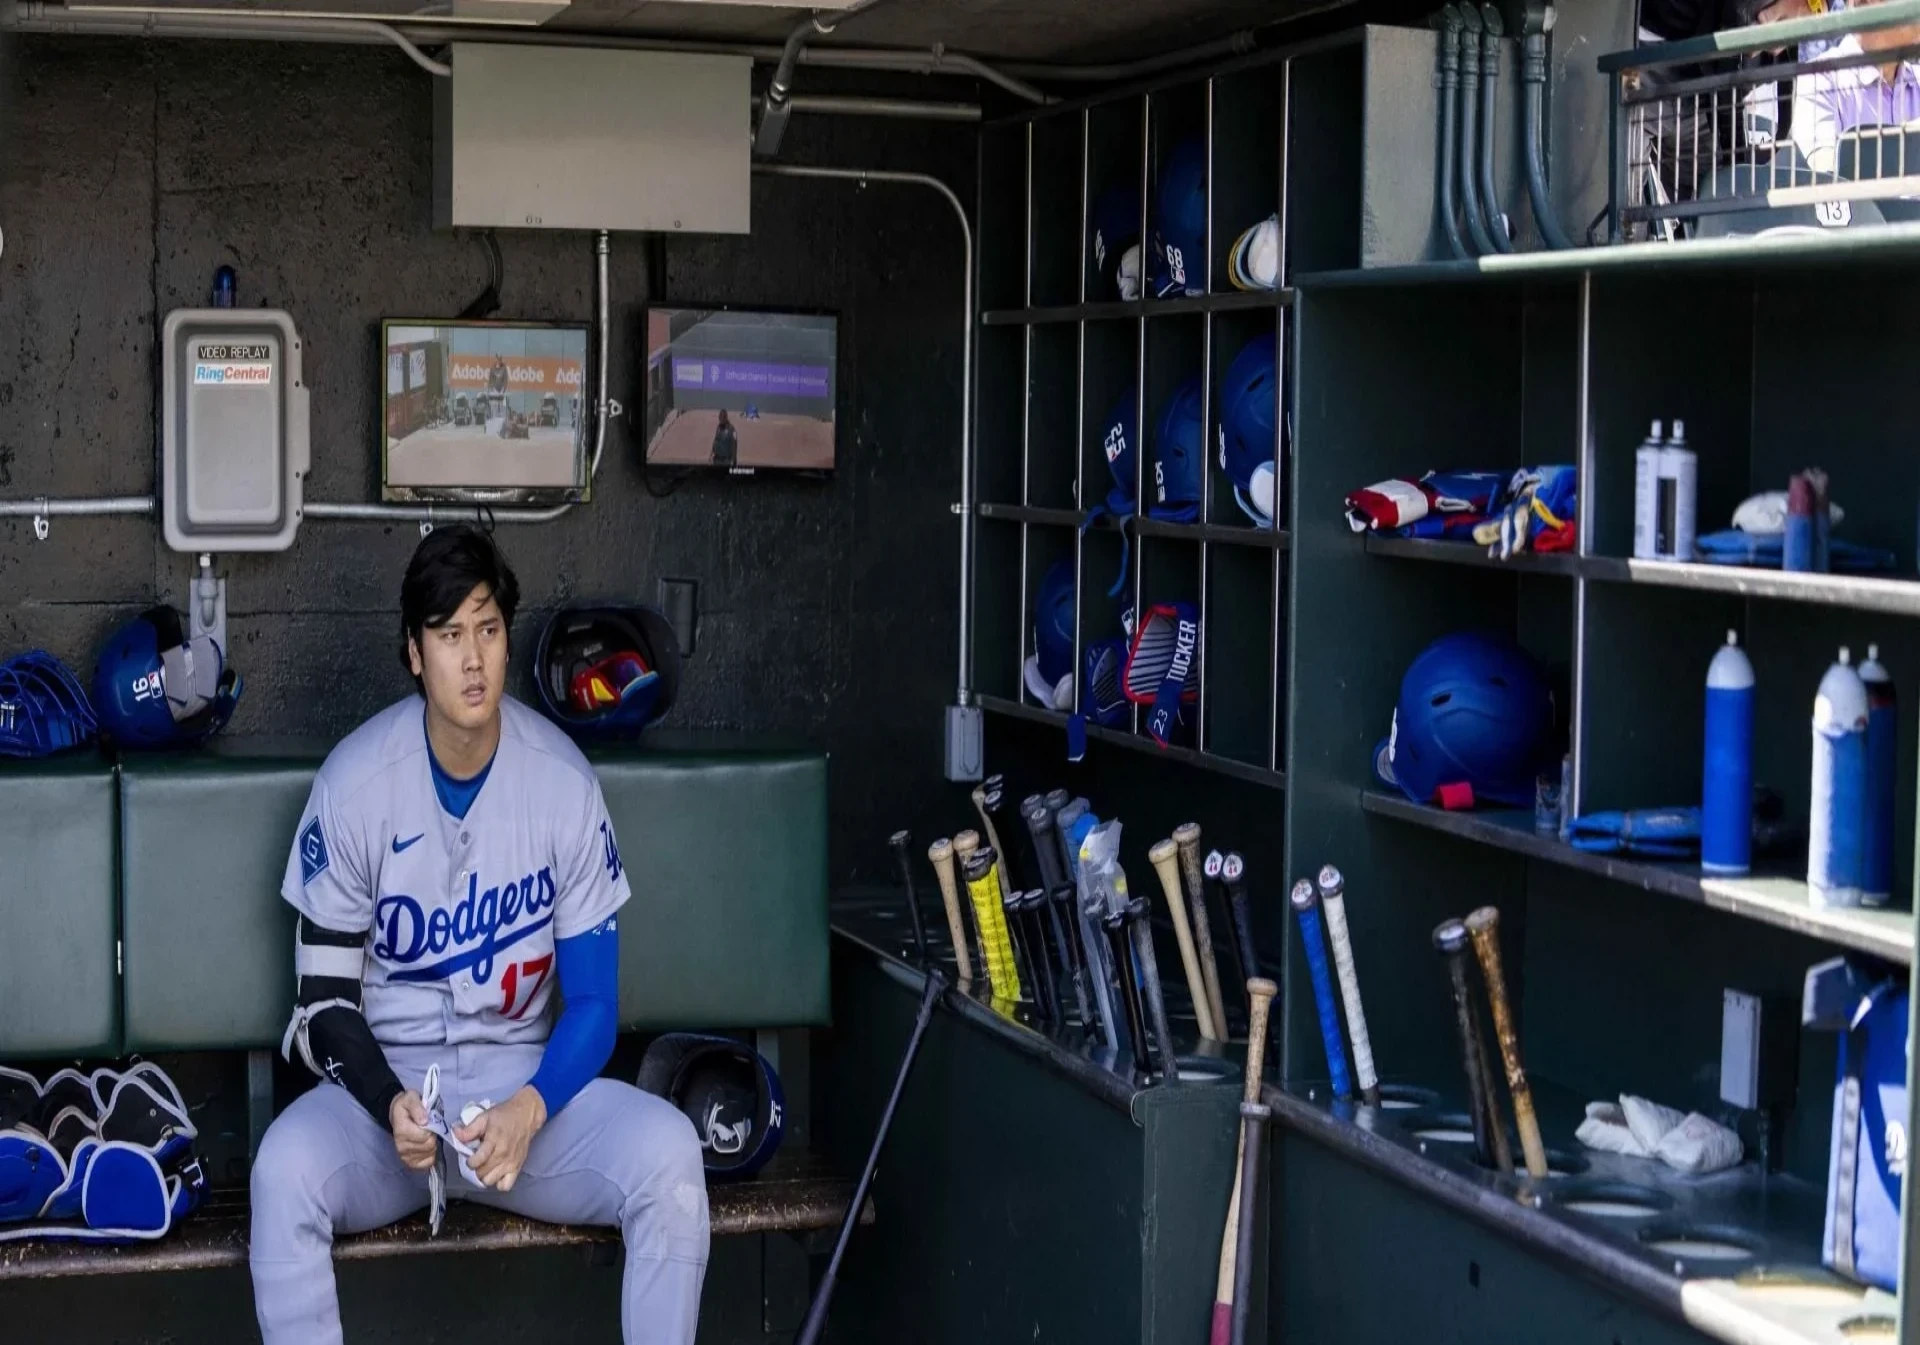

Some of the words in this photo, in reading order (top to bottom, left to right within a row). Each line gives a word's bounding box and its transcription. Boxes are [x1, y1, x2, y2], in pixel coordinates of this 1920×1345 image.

[1822, 200, 1842, 221] 13
[200, 347, 226, 359] VIDEO
[230, 347, 267, 359] REPLAY
[196, 366, 270, 382] RingCentral
[1111, 423, 1126, 455] 25
[1165, 619, 1197, 682] TUCKER
[133, 677, 150, 701] 16
[1153, 709, 1168, 735] 23
[306, 833, 320, 860] G
[374, 866, 556, 985] Dodgers
[498, 952, 554, 1020] 17
